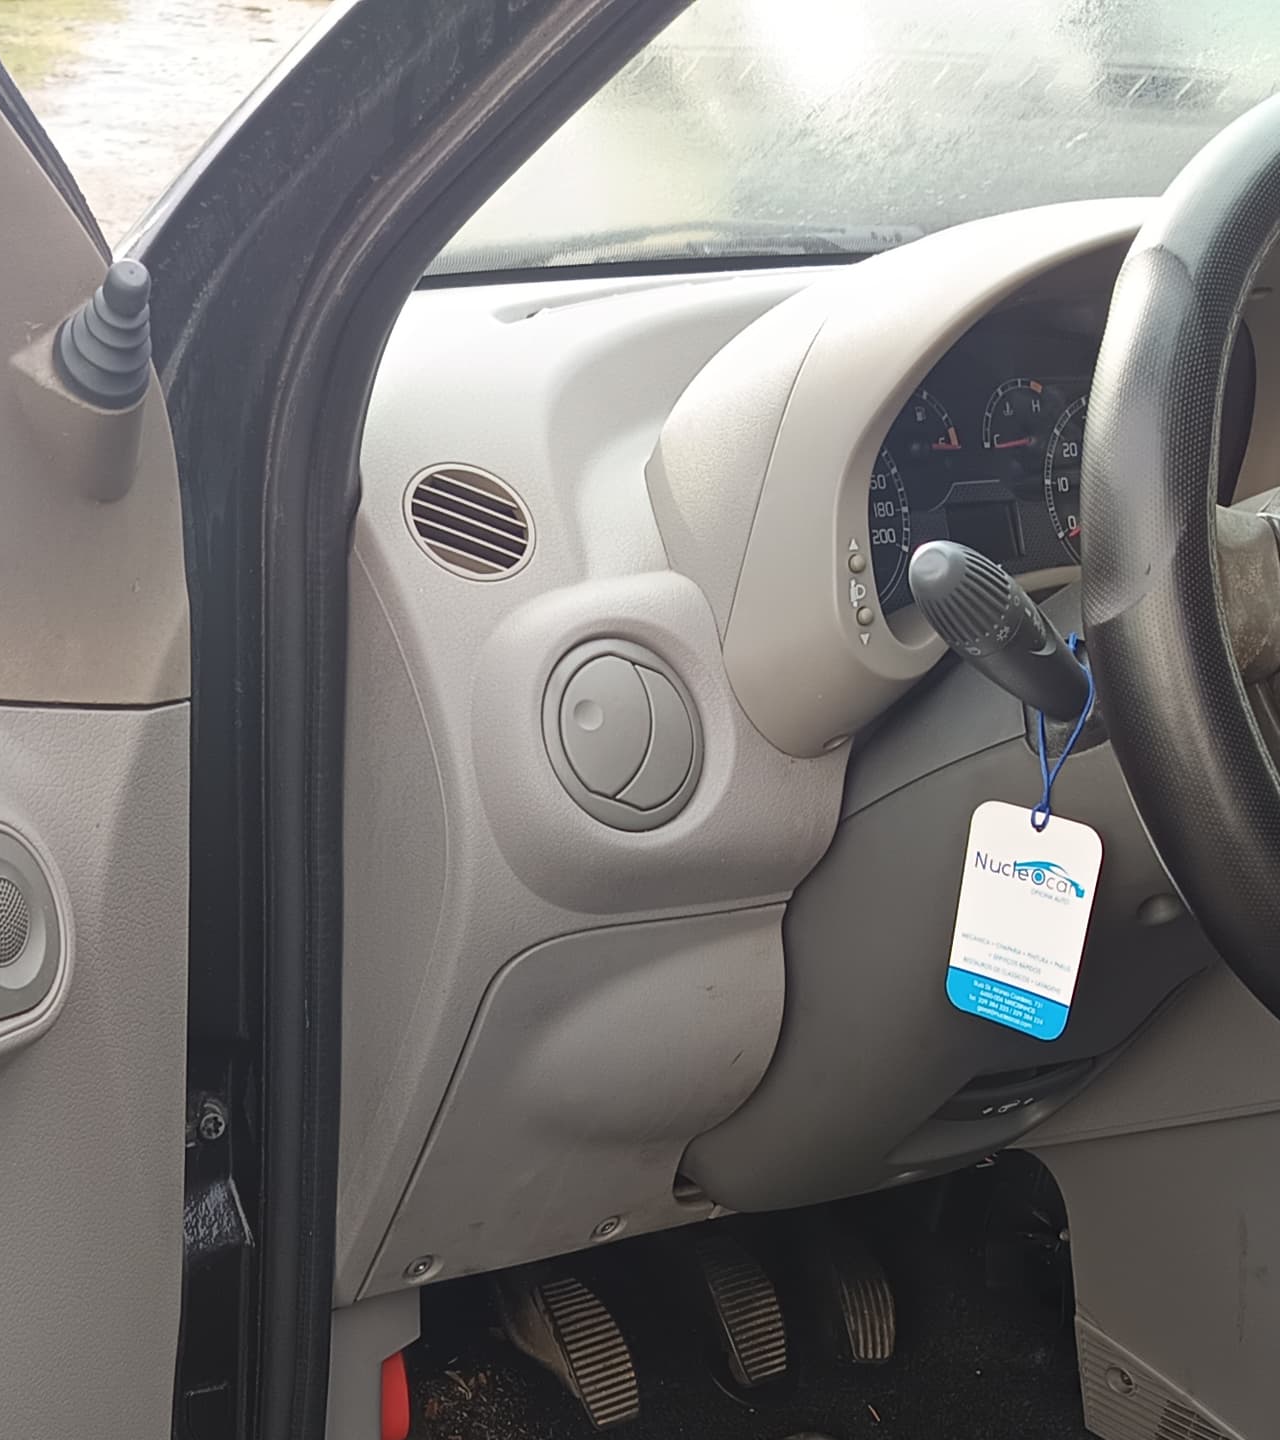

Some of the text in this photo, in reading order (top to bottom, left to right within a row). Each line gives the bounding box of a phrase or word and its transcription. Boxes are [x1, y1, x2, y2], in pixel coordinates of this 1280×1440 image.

[1032, 400, 1040, 413] H
[1062, 443, 1078, 457] 20
[1057, 477, 1069, 492] 10
[873, 501, 894, 518] 180
[1068, 515, 1077, 529] 0
[872, 528, 896, 544] 200
